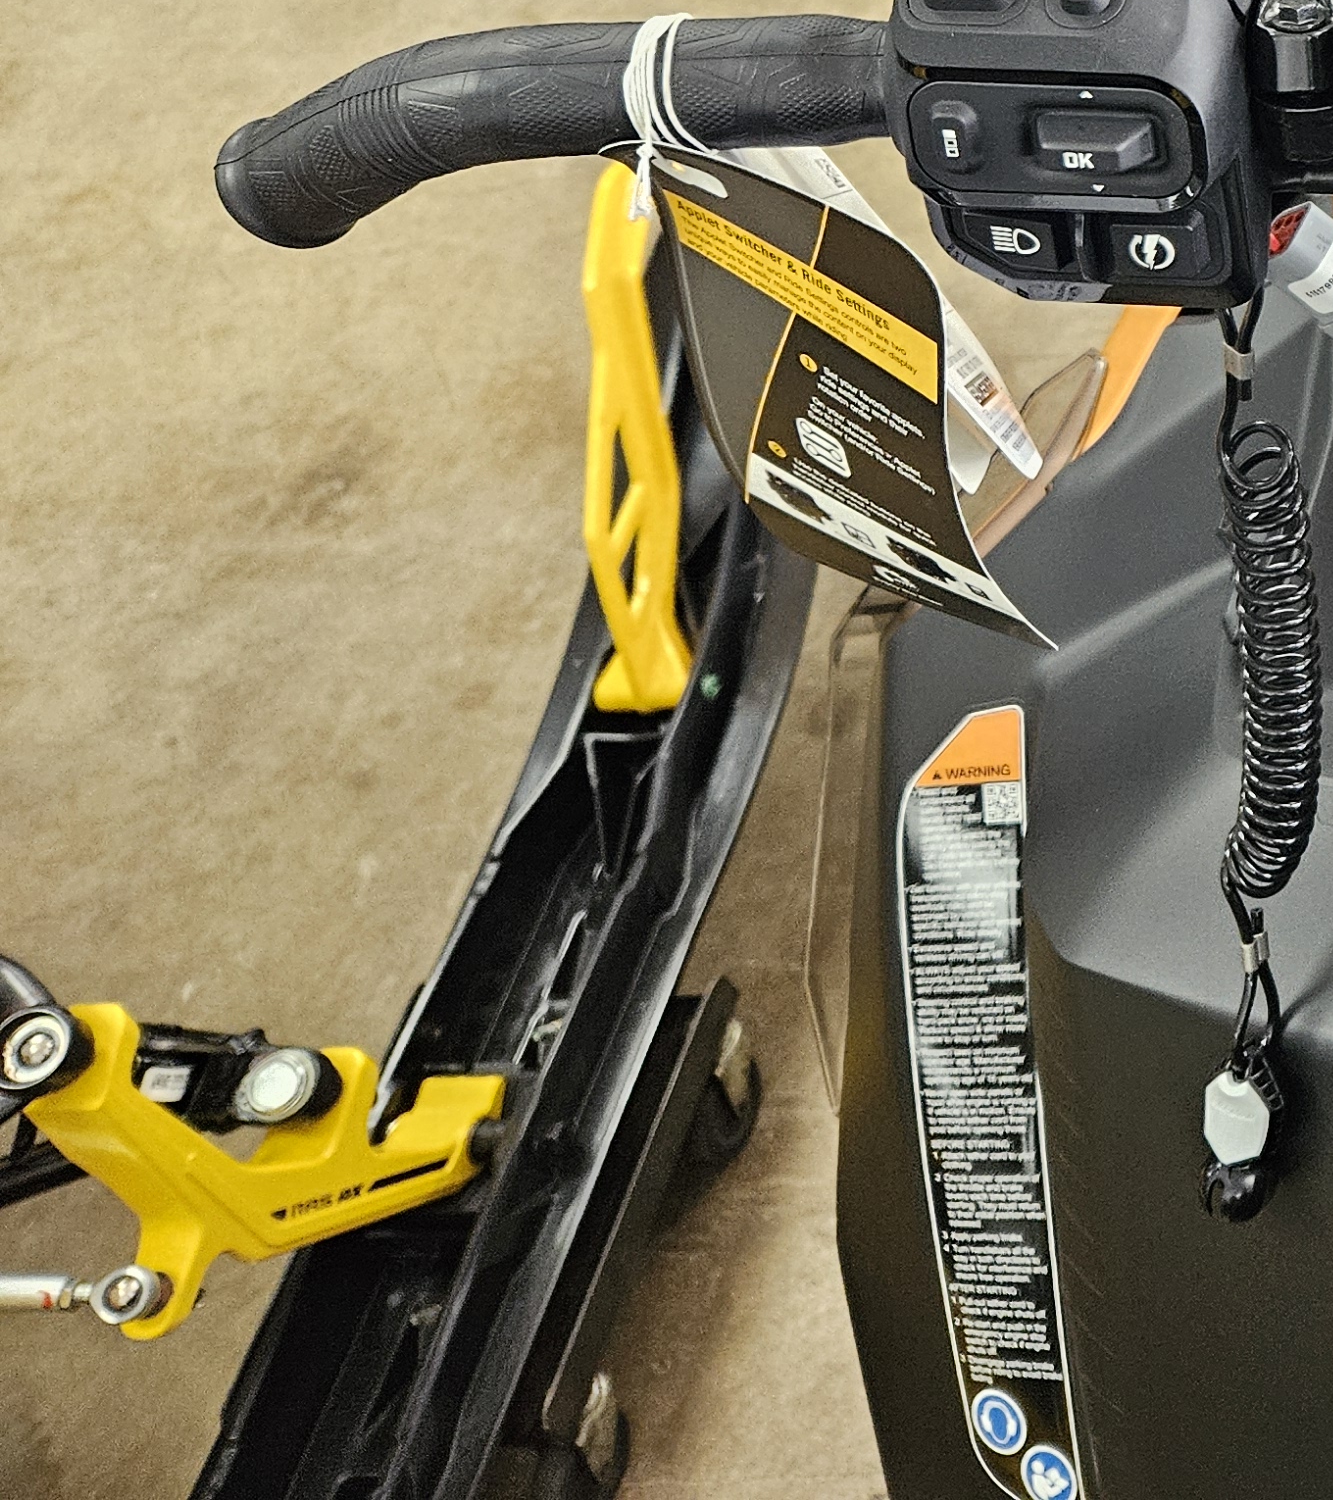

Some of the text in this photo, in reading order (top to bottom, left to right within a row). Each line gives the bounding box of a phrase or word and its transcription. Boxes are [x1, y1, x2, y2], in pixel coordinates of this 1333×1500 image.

[1062, 151, 1095, 171] OK
[677, 200, 889, 332] Applet Switcher & Ride Settings
[823, 309, 853, 333] content
[855, 330, 866, 342] on
[868, 338, 886, 354] your
[888, 350, 917, 376] display
[891, 341, 906, 356] two
[945, 763, 1010, 779] WARNING
